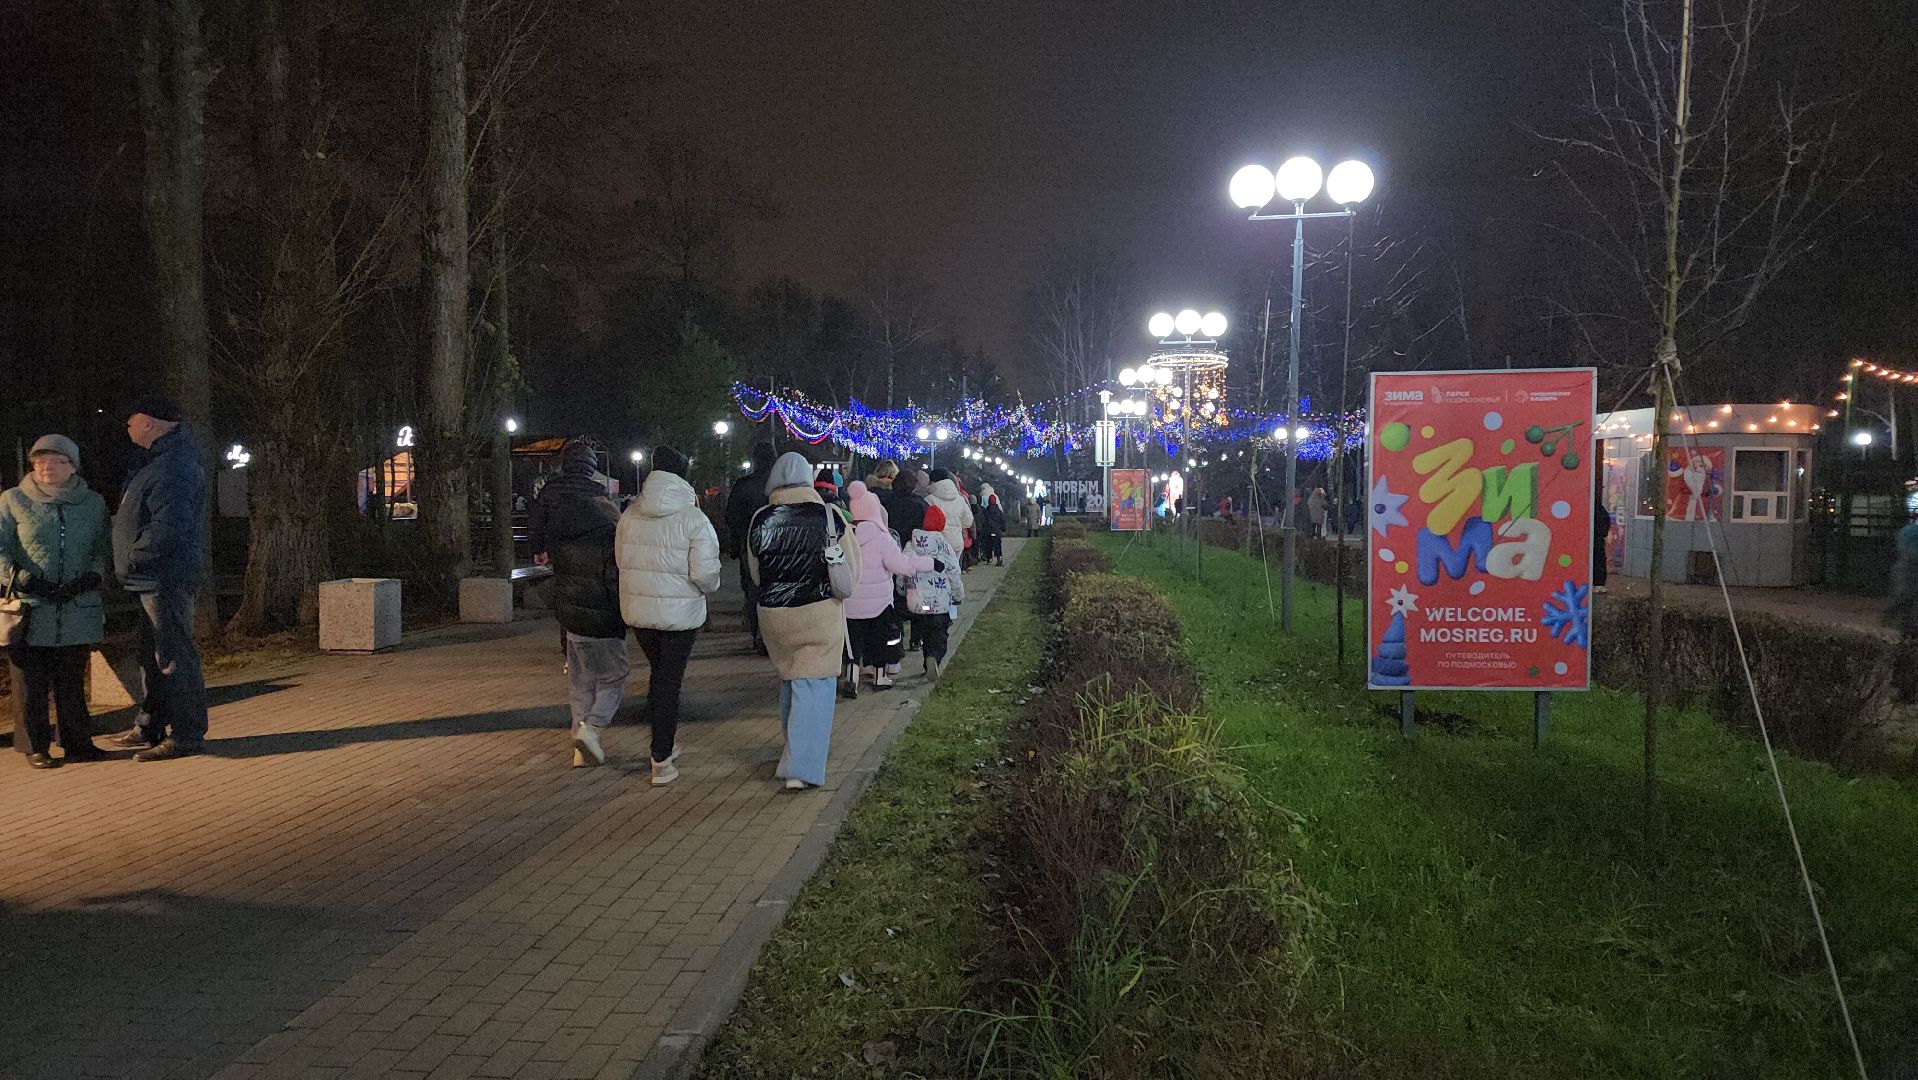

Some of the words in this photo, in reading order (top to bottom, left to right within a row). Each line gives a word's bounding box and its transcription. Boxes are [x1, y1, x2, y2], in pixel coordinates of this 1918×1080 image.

[1054, 480, 1099, 494] НОВЫМ
[1425, 607, 1532, 622] WELCOME.
[1420, 627, 1538, 643] MOSREG.RU
[1445, 652, 1511, 660] ПУТЕВОДИТЕЛЬ
[1451, 660, 1517, 669] ПОДМОСКОВЬЮ
